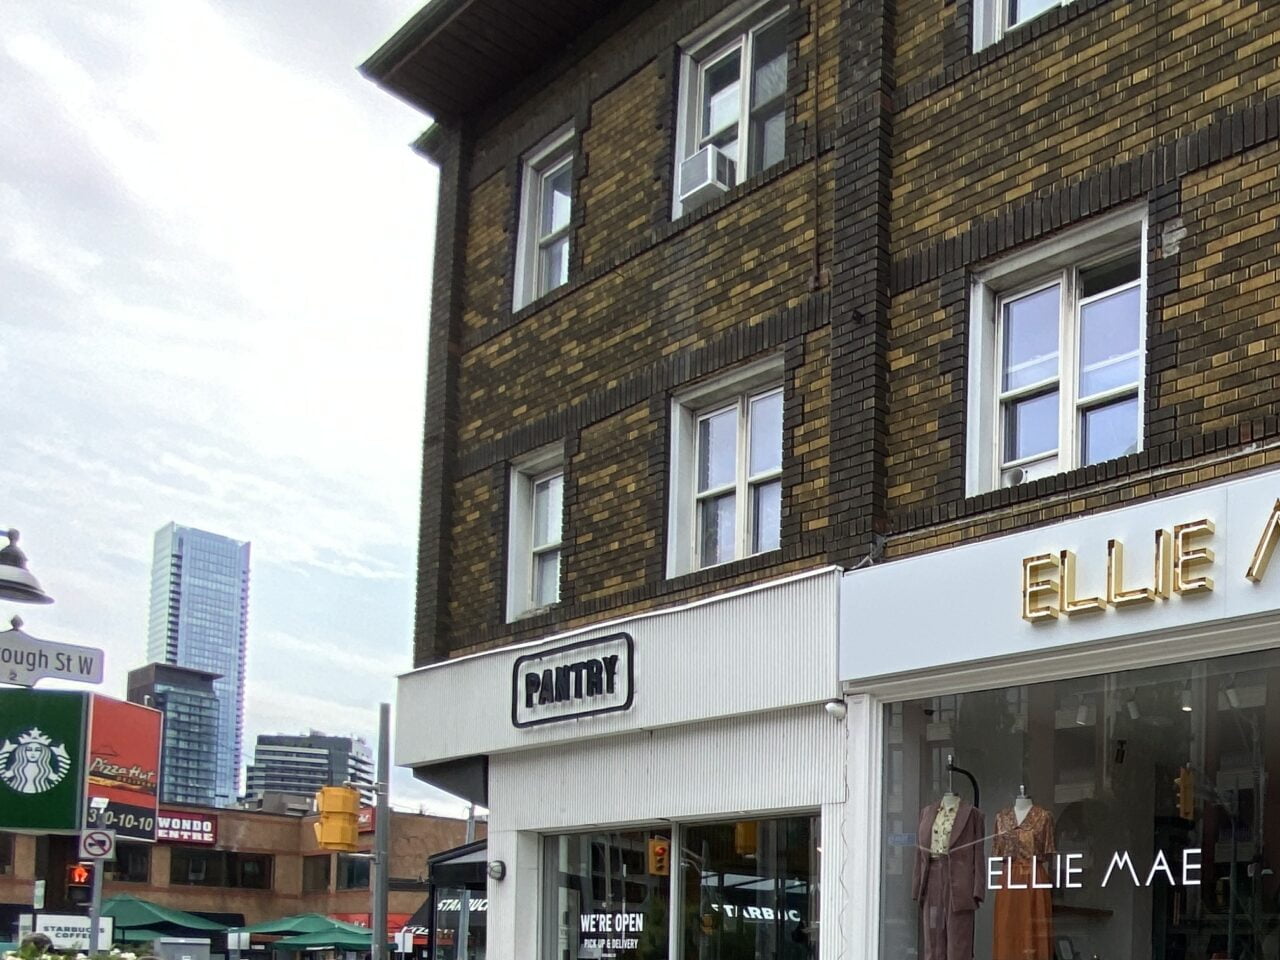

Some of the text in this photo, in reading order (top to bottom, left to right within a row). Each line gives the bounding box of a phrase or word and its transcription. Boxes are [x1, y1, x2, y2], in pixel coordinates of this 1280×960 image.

[1022, 518, 1216, 623] ELLIE
[0, 647, 93, 675] ough St W
[525, 654, 619, 708] PANTRY
[88, 757, 156, 781] Pizza Hut
[88, 808, 153, 832] 30-10-10
[987, 848, 1202, 890] ELLIE MAE
[43, 925, 104, 934] STARBUCS
[580, 913, 643, 932] WE'RE OPEN
[584, 938, 597, 949] PICK
[612, 938, 639, 949] DELIVERY
